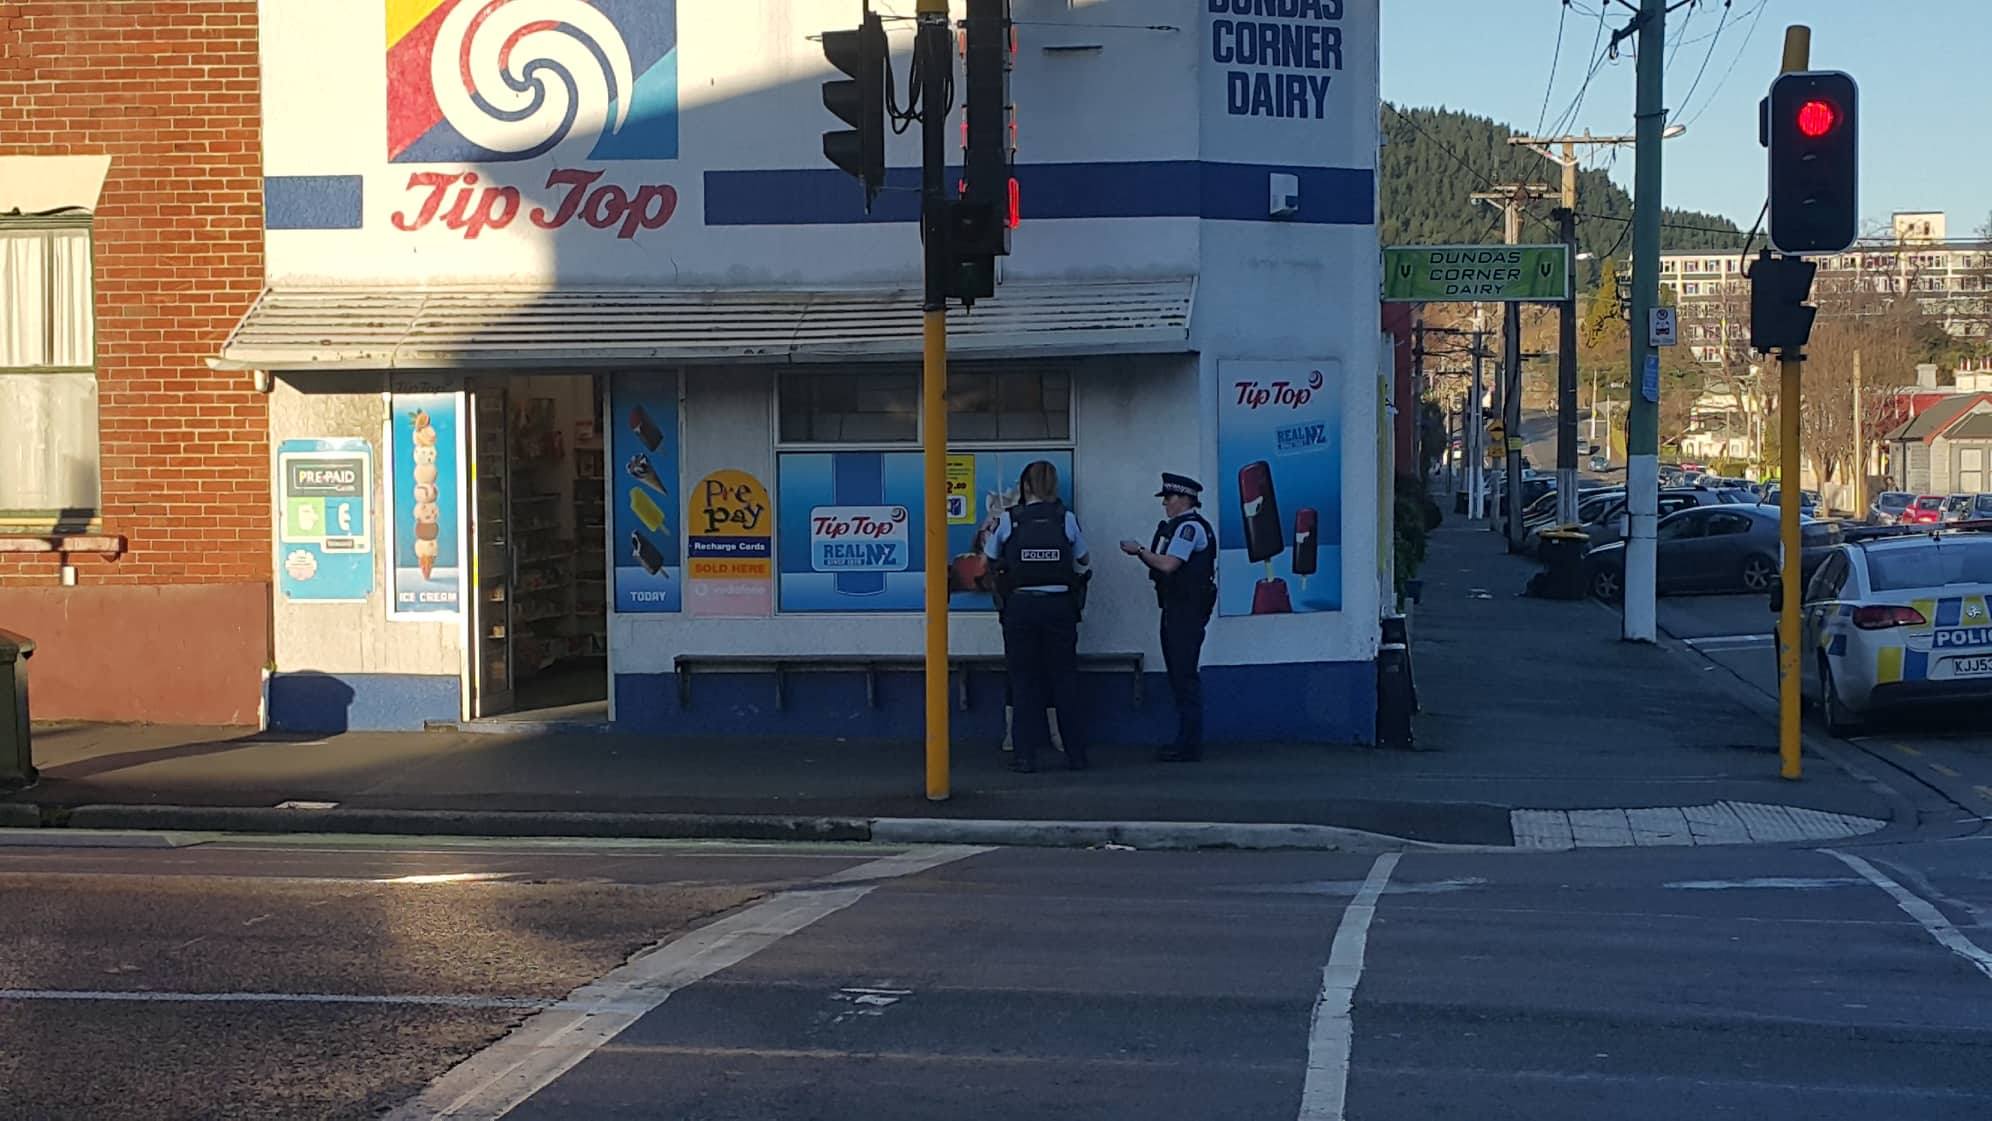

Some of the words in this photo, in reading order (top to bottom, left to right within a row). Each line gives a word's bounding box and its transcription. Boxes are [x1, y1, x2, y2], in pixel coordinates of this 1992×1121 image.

[1213, 19, 1342, 70] CORNER
[1227, 71, 1331, 119] DAIRY
[391, 171, 521, 239] Tip
[529, 168, 679, 239] Top
[1430, 251, 1521, 264] DUNDAS
[1429, 268, 1521, 281] CORNER
[1445, 284, 1505, 295] DAIRY
[1235, 381, 1270, 410] Tip
[1271, 381, 1311, 410] Top
[1277, 427, 1304, 442] REAL
[1304, 424, 1326, 445] NZ
[704, 480, 752, 507] Pre
[703, 503, 765, 533] pay
[813, 516, 850, 539] Tip
[850, 516, 894, 539] Top
[694, 542, 737, 552] Recharge
[739, 542, 766, 551] Cards
[823, 543, 865, 559] REAL
[865, 543, 897, 566] NZ
[1024, 551, 1057, 560] POLICE
[694, 563, 728, 574] SOLD
[731, 563, 767, 574] HERE
[399, 591, 417, 603] ICE
[630, 591, 667, 602] TODAY
[1937, 629, 1992, 646] POLI
